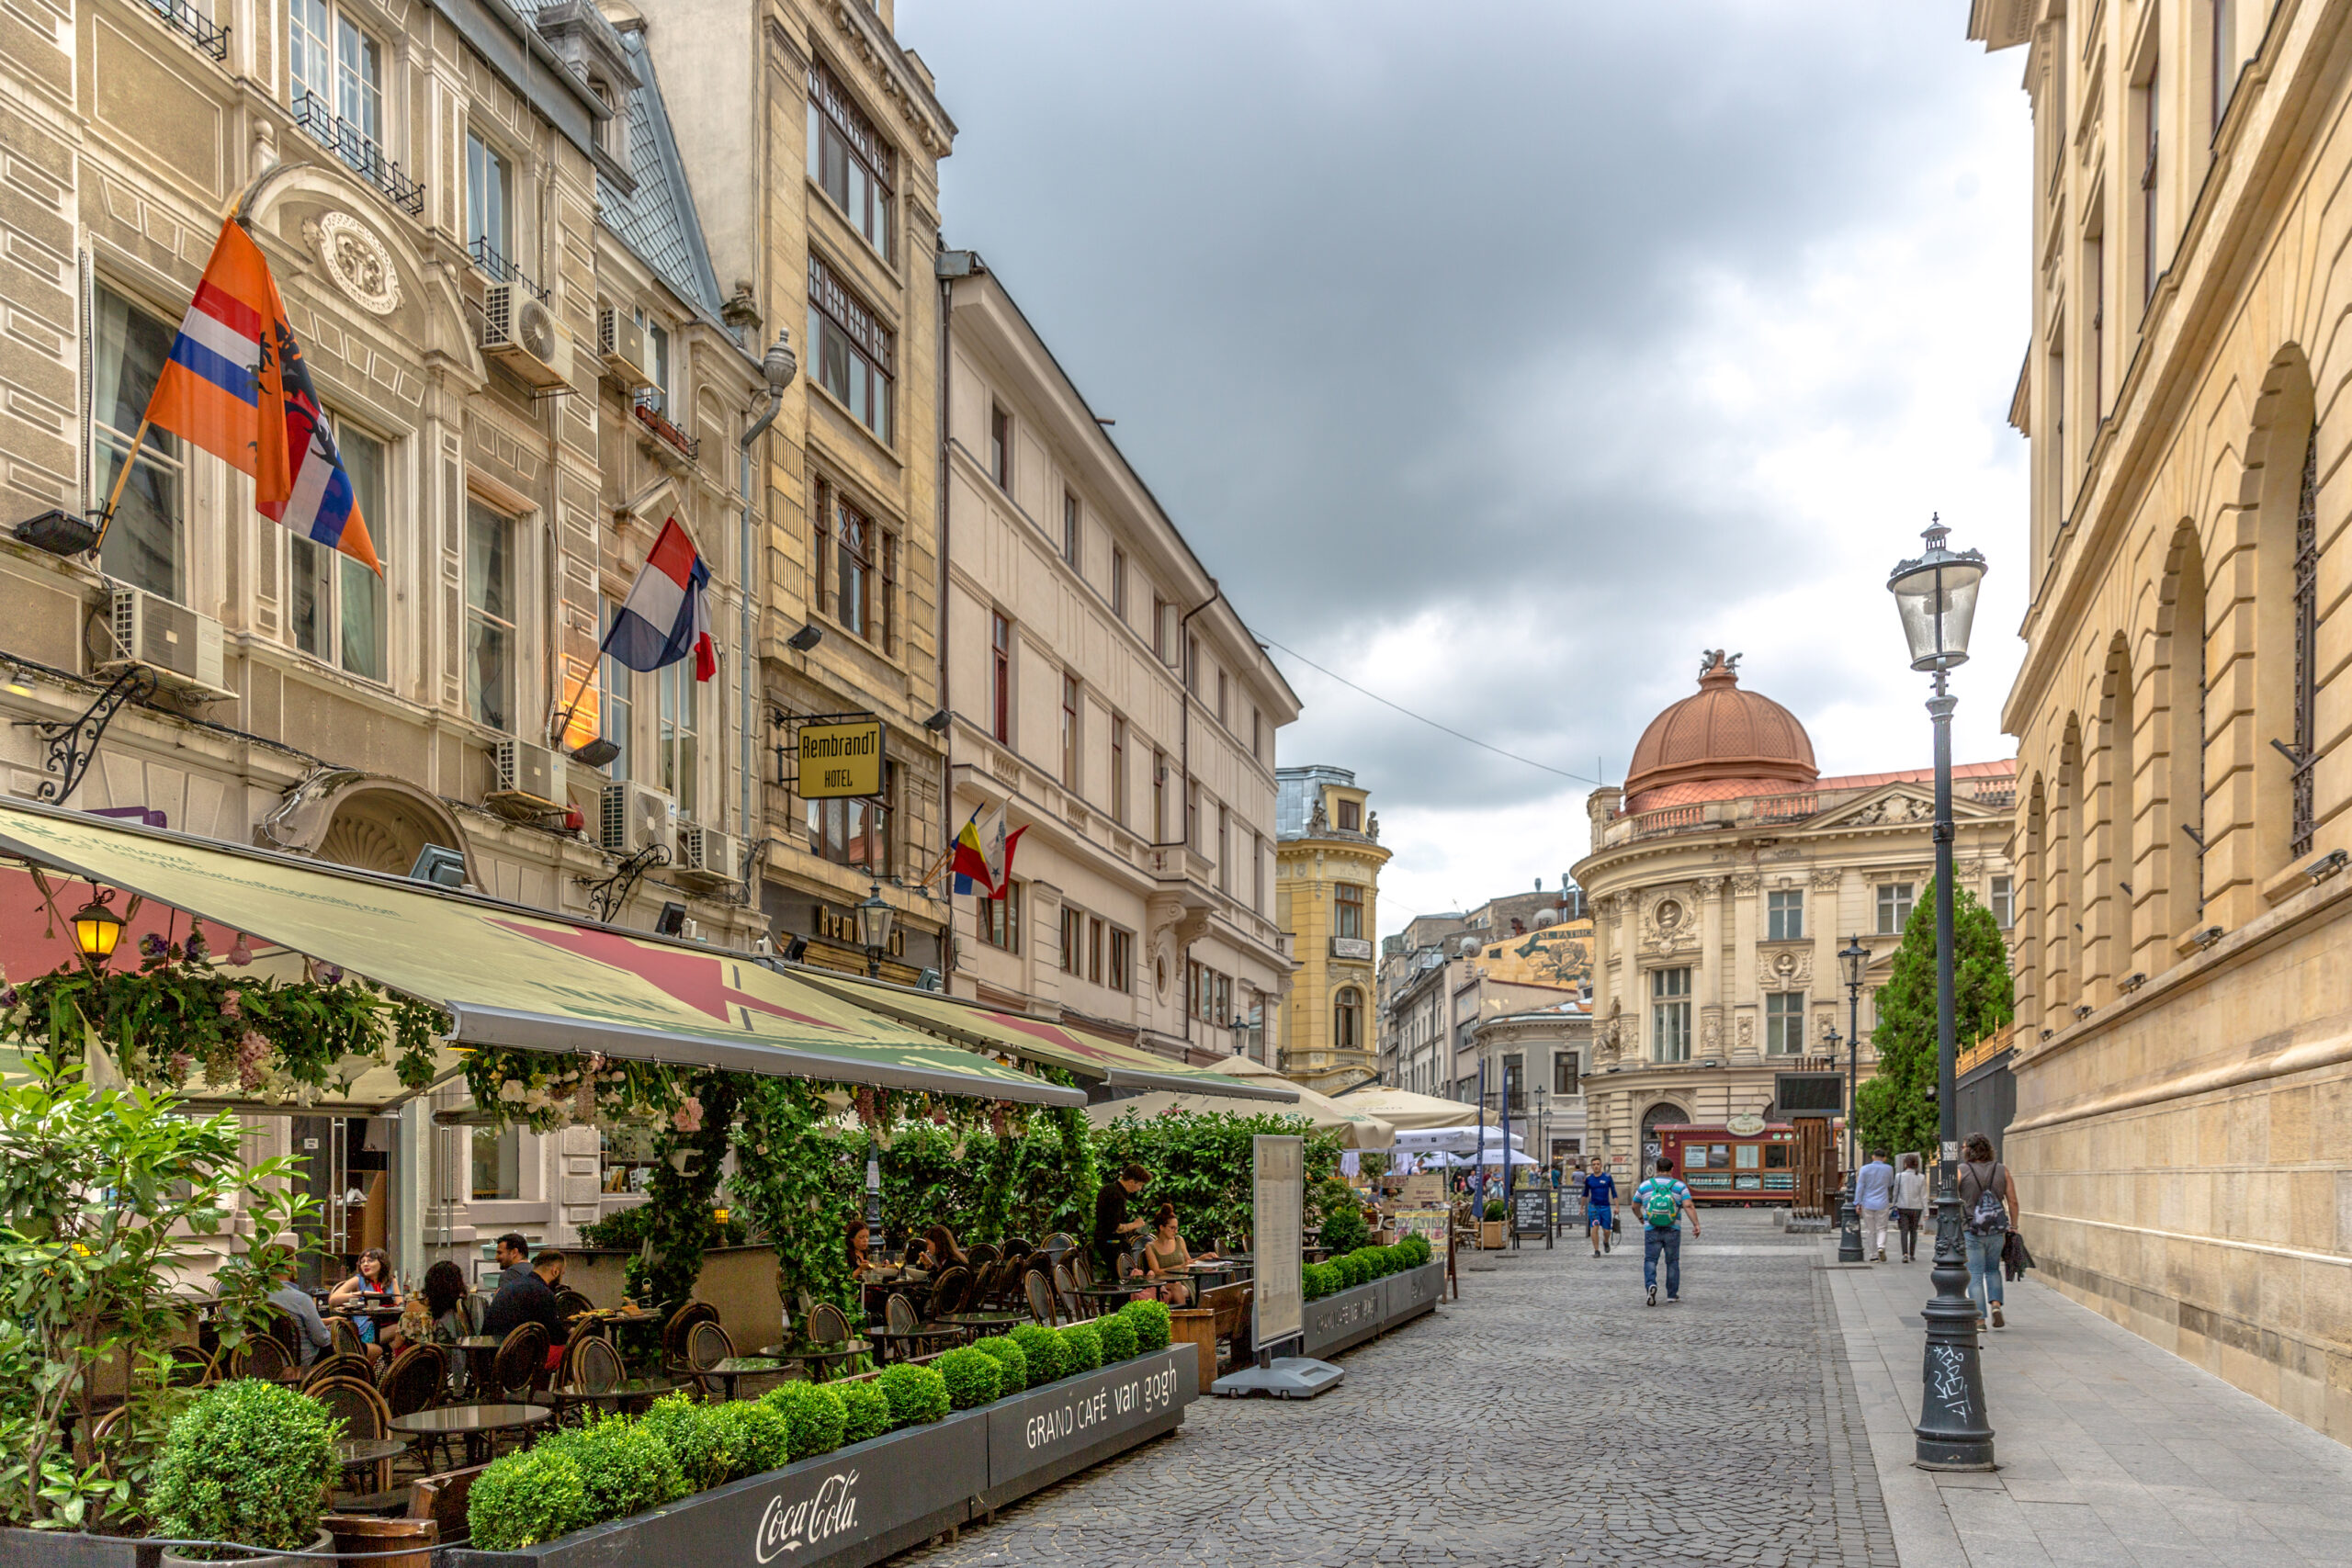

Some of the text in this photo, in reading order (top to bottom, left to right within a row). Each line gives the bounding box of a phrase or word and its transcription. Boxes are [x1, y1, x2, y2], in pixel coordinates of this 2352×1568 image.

[824, 768, 853, 788] HOTEL
[1026, 1358, 1177, 1450] GRAND CAFÉ van gogh
